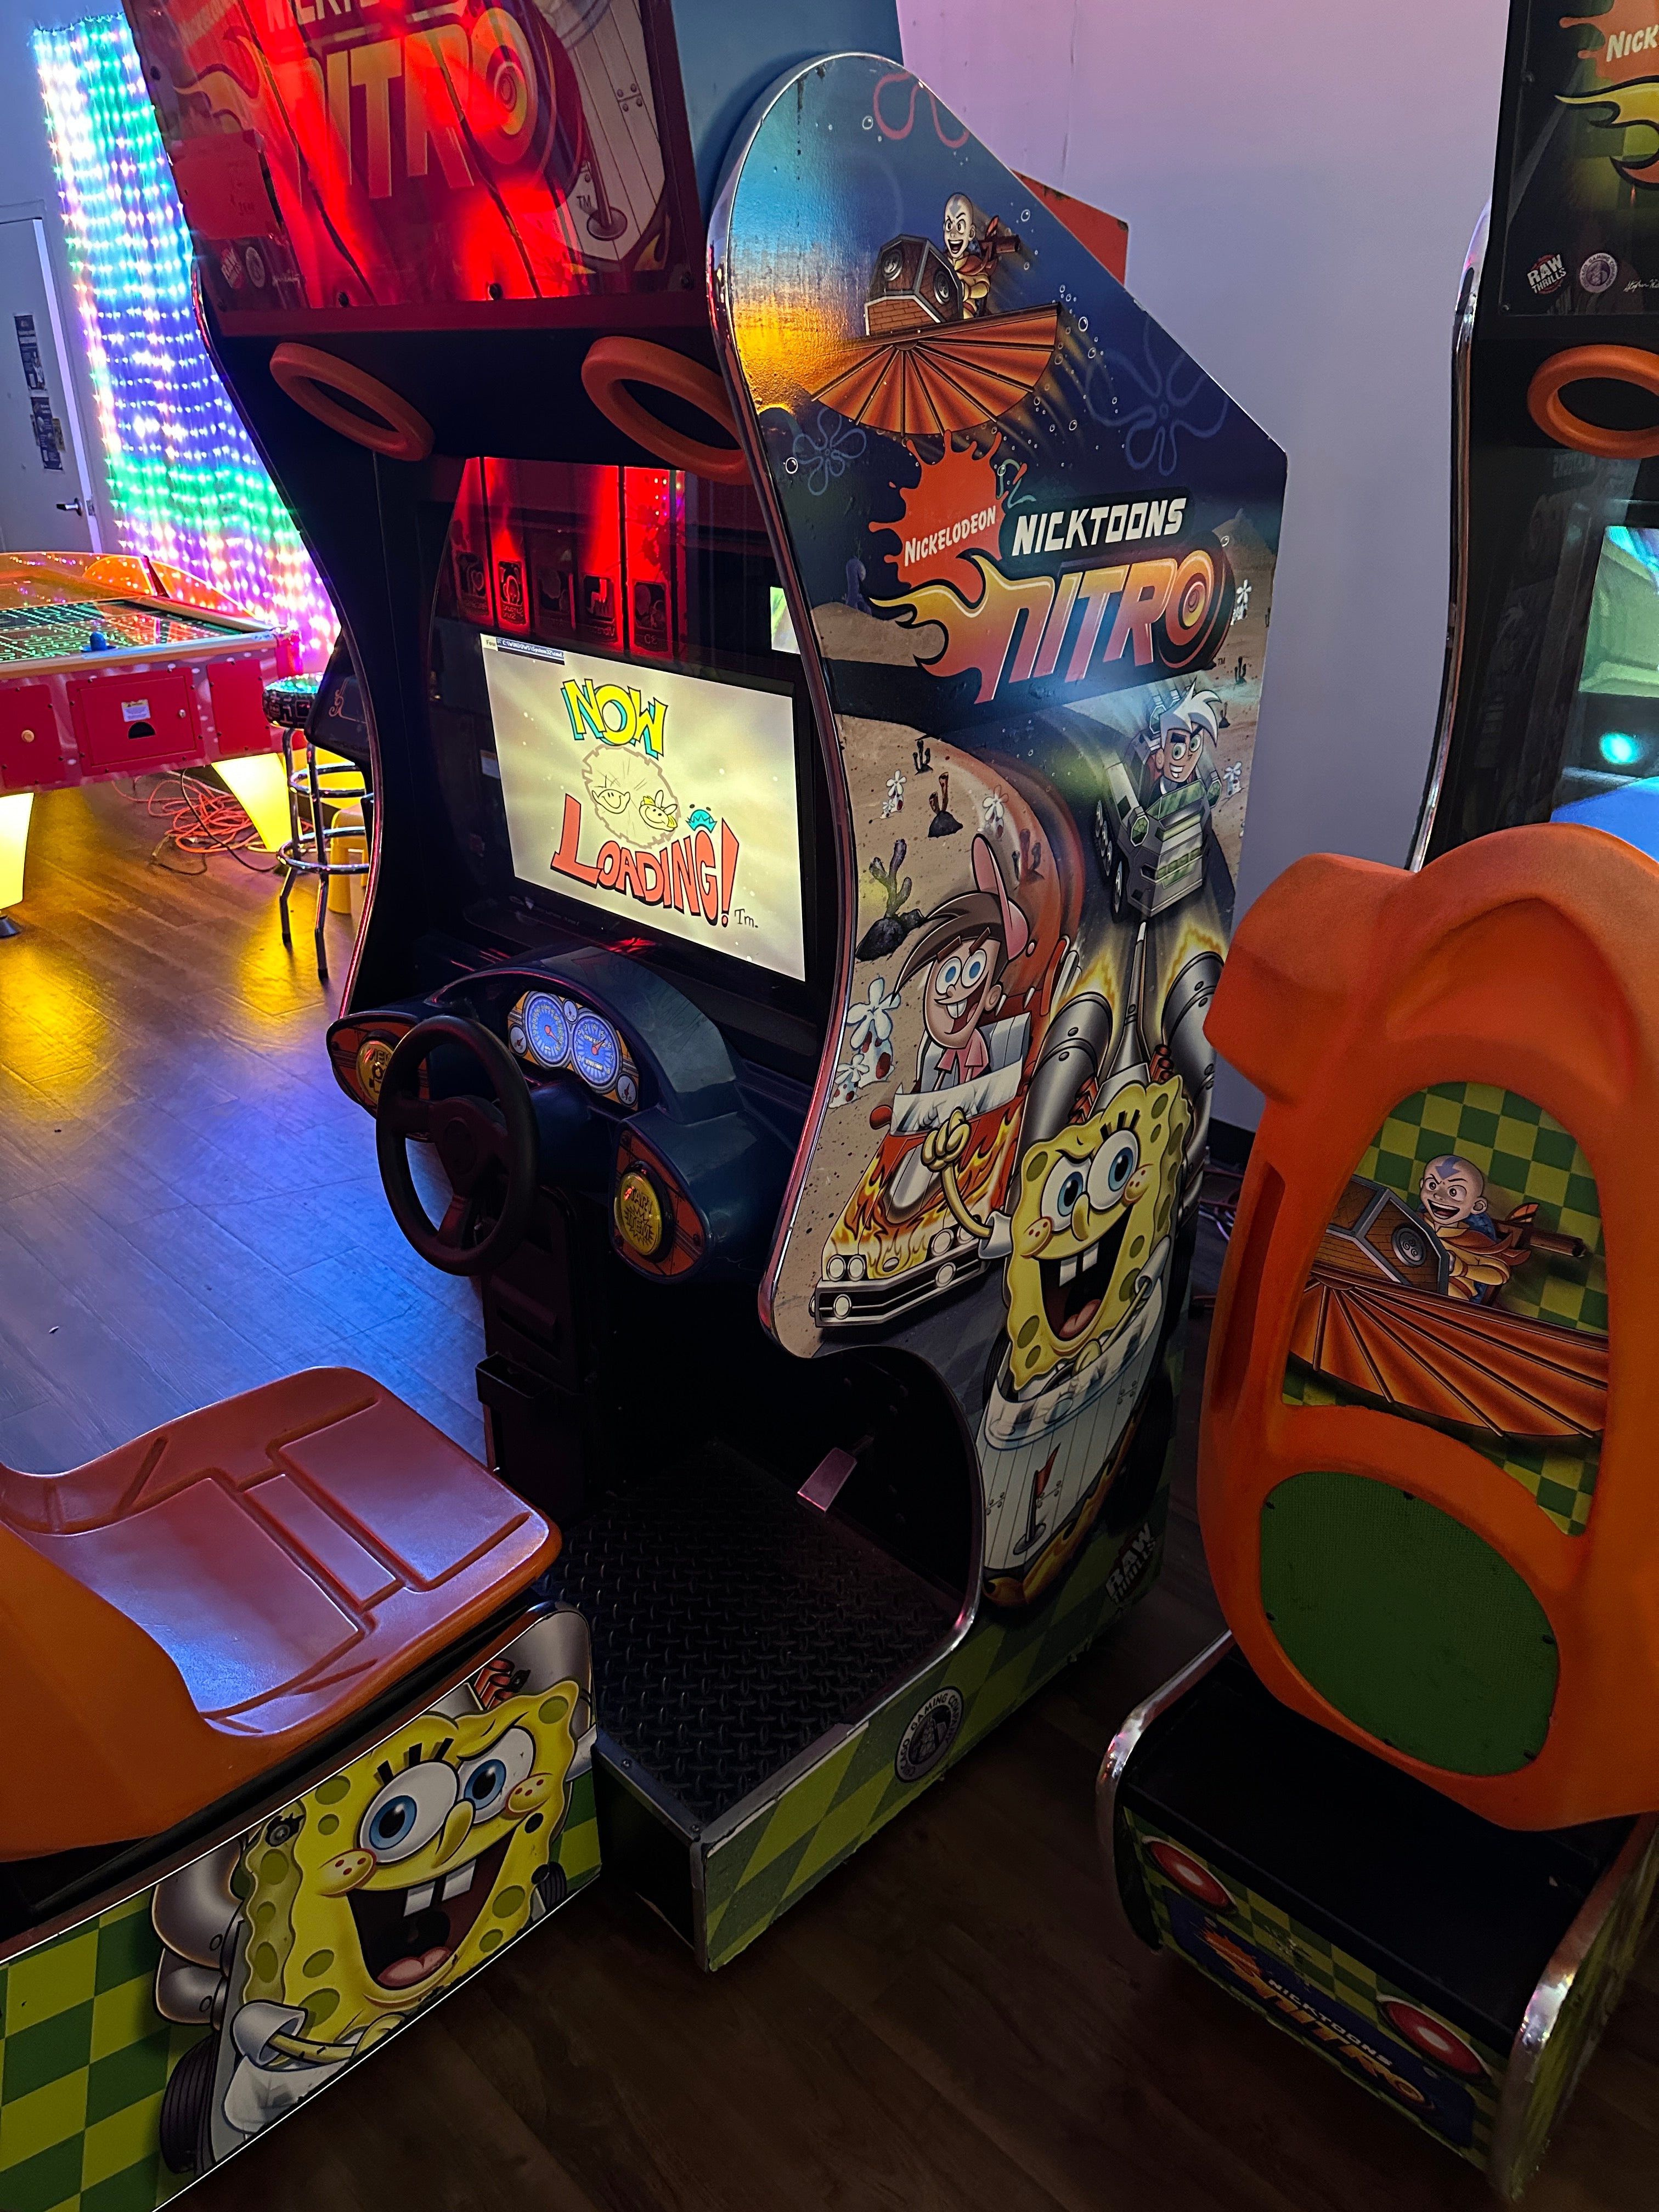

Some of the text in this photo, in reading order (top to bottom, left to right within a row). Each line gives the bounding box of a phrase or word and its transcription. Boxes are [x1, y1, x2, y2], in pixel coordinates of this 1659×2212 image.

[1527, 253, 1564, 286] RAW
[1531, 267, 1567, 294] THRILLS
[1588, 254, 1611, 263] GAMING
[904, 505, 997, 567] NICKELODEON
[1011, 497, 1187, 557] NICKTOONS
[881, 550, 1215, 704] NITRO
[561, 678, 668, 760] NOW
[550, 793, 740, 928] LOADING!
[627, 1211, 650, 1240] ITEM
[1105, 1522, 1150, 1598] RAW
[911, 1692, 949, 1731] GAMING
[1267, 1978, 1393, 2066] NICKTOONS
